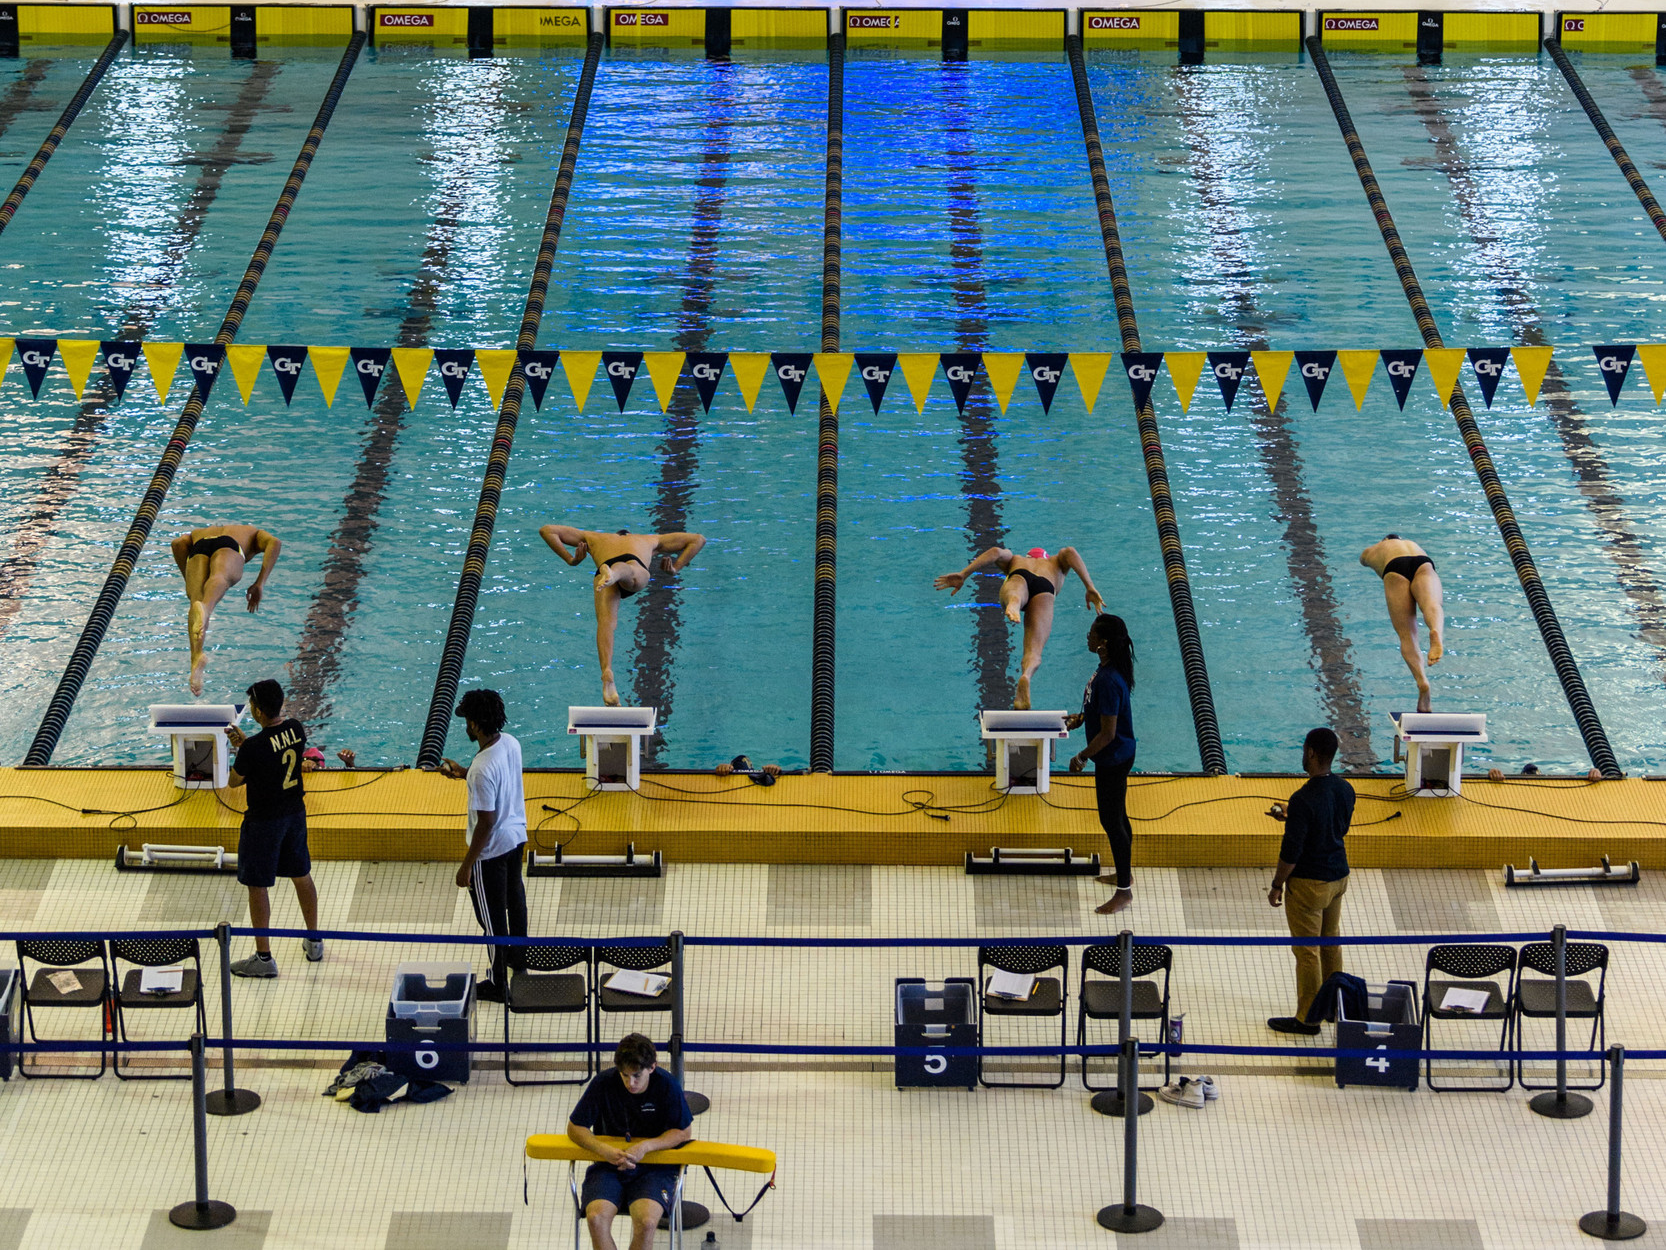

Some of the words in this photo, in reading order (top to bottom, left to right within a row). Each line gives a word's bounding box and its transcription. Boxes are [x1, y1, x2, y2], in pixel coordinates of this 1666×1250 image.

[150, 13, 191, 23] OMEGA
[384, 15, 429, 26] OMEGA
[540, 16, 581, 27] MEGA
[1092, 17, 1139, 29] OMEGA
[1338, 19, 1378, 29] OMEGA
[22, 350, 50, 368] GT
[107, 353, 135, 371] GT
[190, 356, 218, 374] GT
[273, 357, 301, 375] GT
[356, 359, 384, 377] GT
[1474, 358, 1502, 376] GT
[1599, 356, 1627, 374] GT
[440, 361, 468, 379] GT
[524, 362, 552, 380] GT
[607, 361, 635, 379] GT
[692, 363, 720, 381] GT
[777, 364, 805, 382] GT
[862, 365, 890, 383] GT
[946, 365, 974, 383] GT
[1032, 365, 1060, 383] GT
[1127, 364, 1155, 382] GT
[1214, 362, 1242, 380] GT
[1301, 362, 1329, 380] GT
[1387, 360, 1415, 378] GT
[282, 748, 298, 790] 2
[415, 1039, 440, 1069] 6
[924, 1045, 948, 1074] 5
[1365, 1044, 1390, 1073] 4
